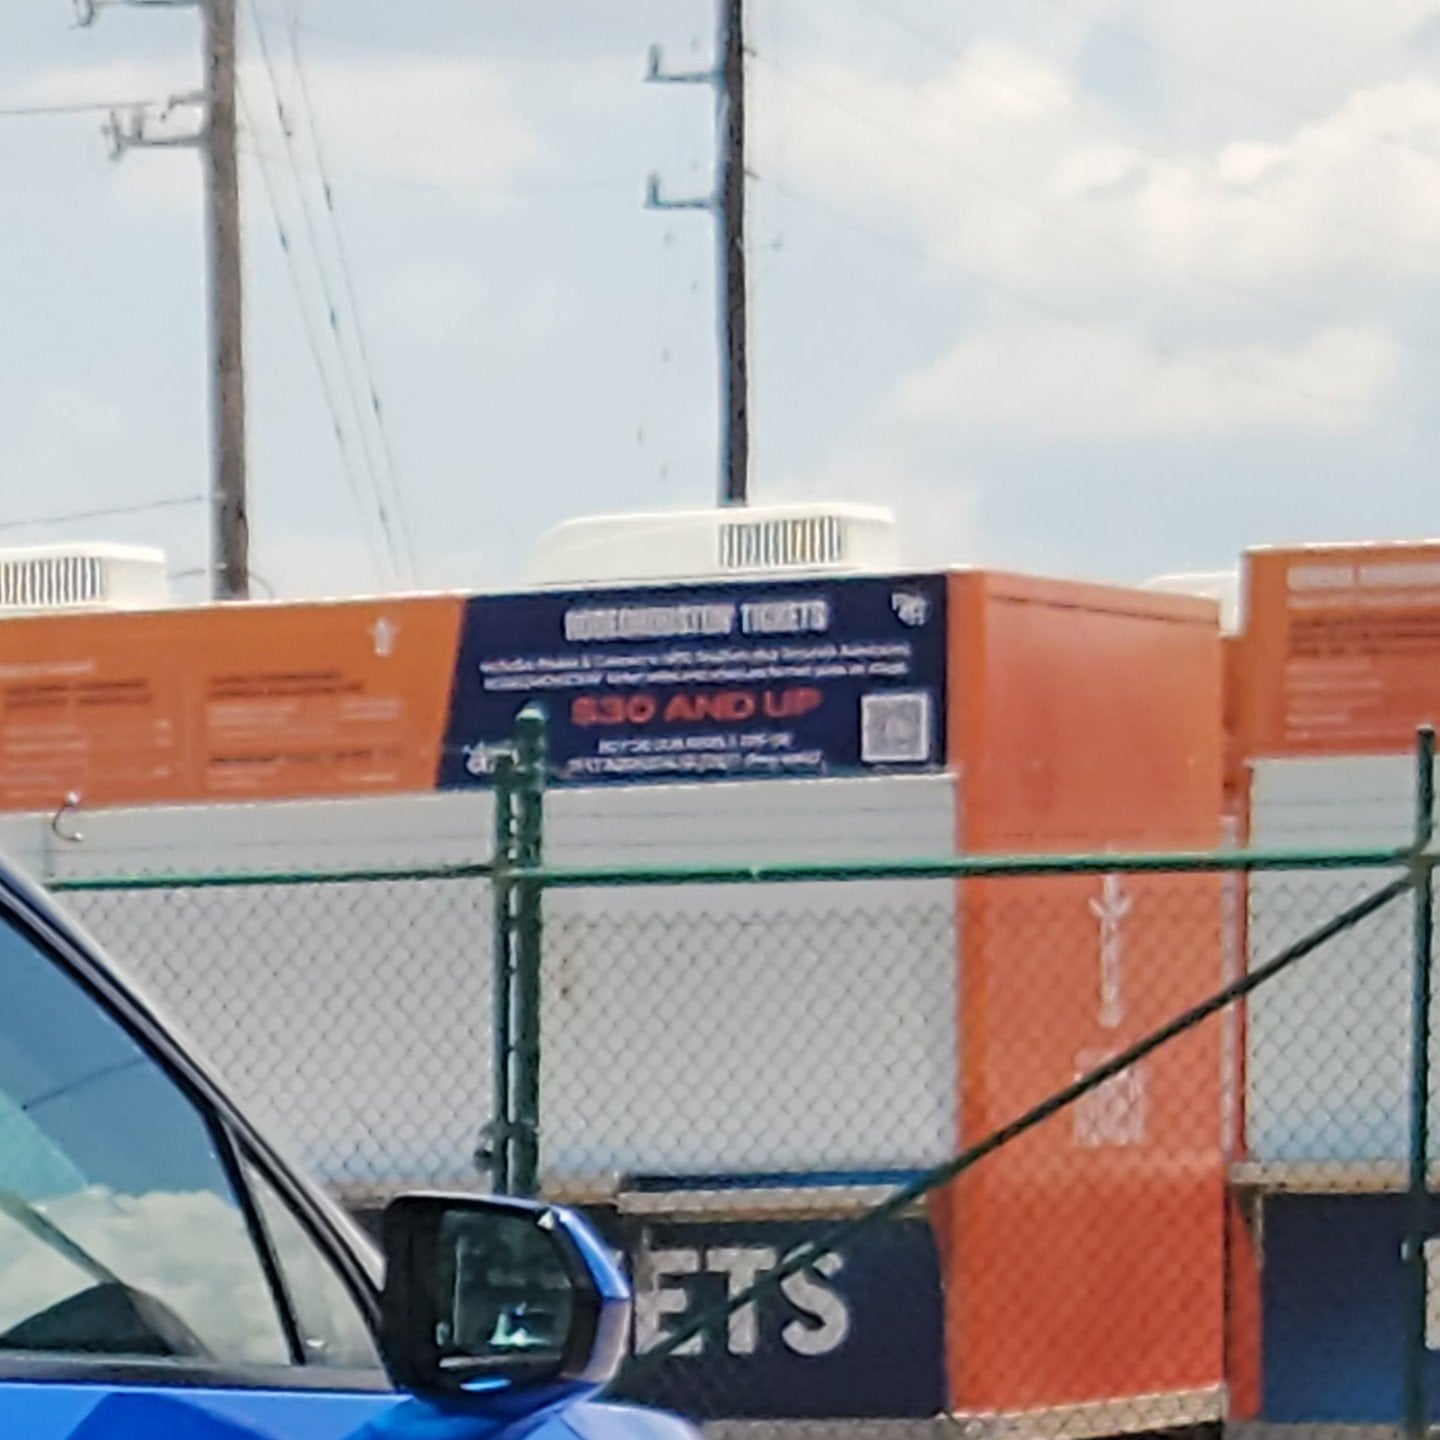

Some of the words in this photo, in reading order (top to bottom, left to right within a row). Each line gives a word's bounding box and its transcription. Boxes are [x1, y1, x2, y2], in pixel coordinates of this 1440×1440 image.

[571, 696, 656, 725] $30
[664, 692, 755, 722] AND
[762, 687, 824, 717] UP
[611, 1246, 849, 1356] ETS
